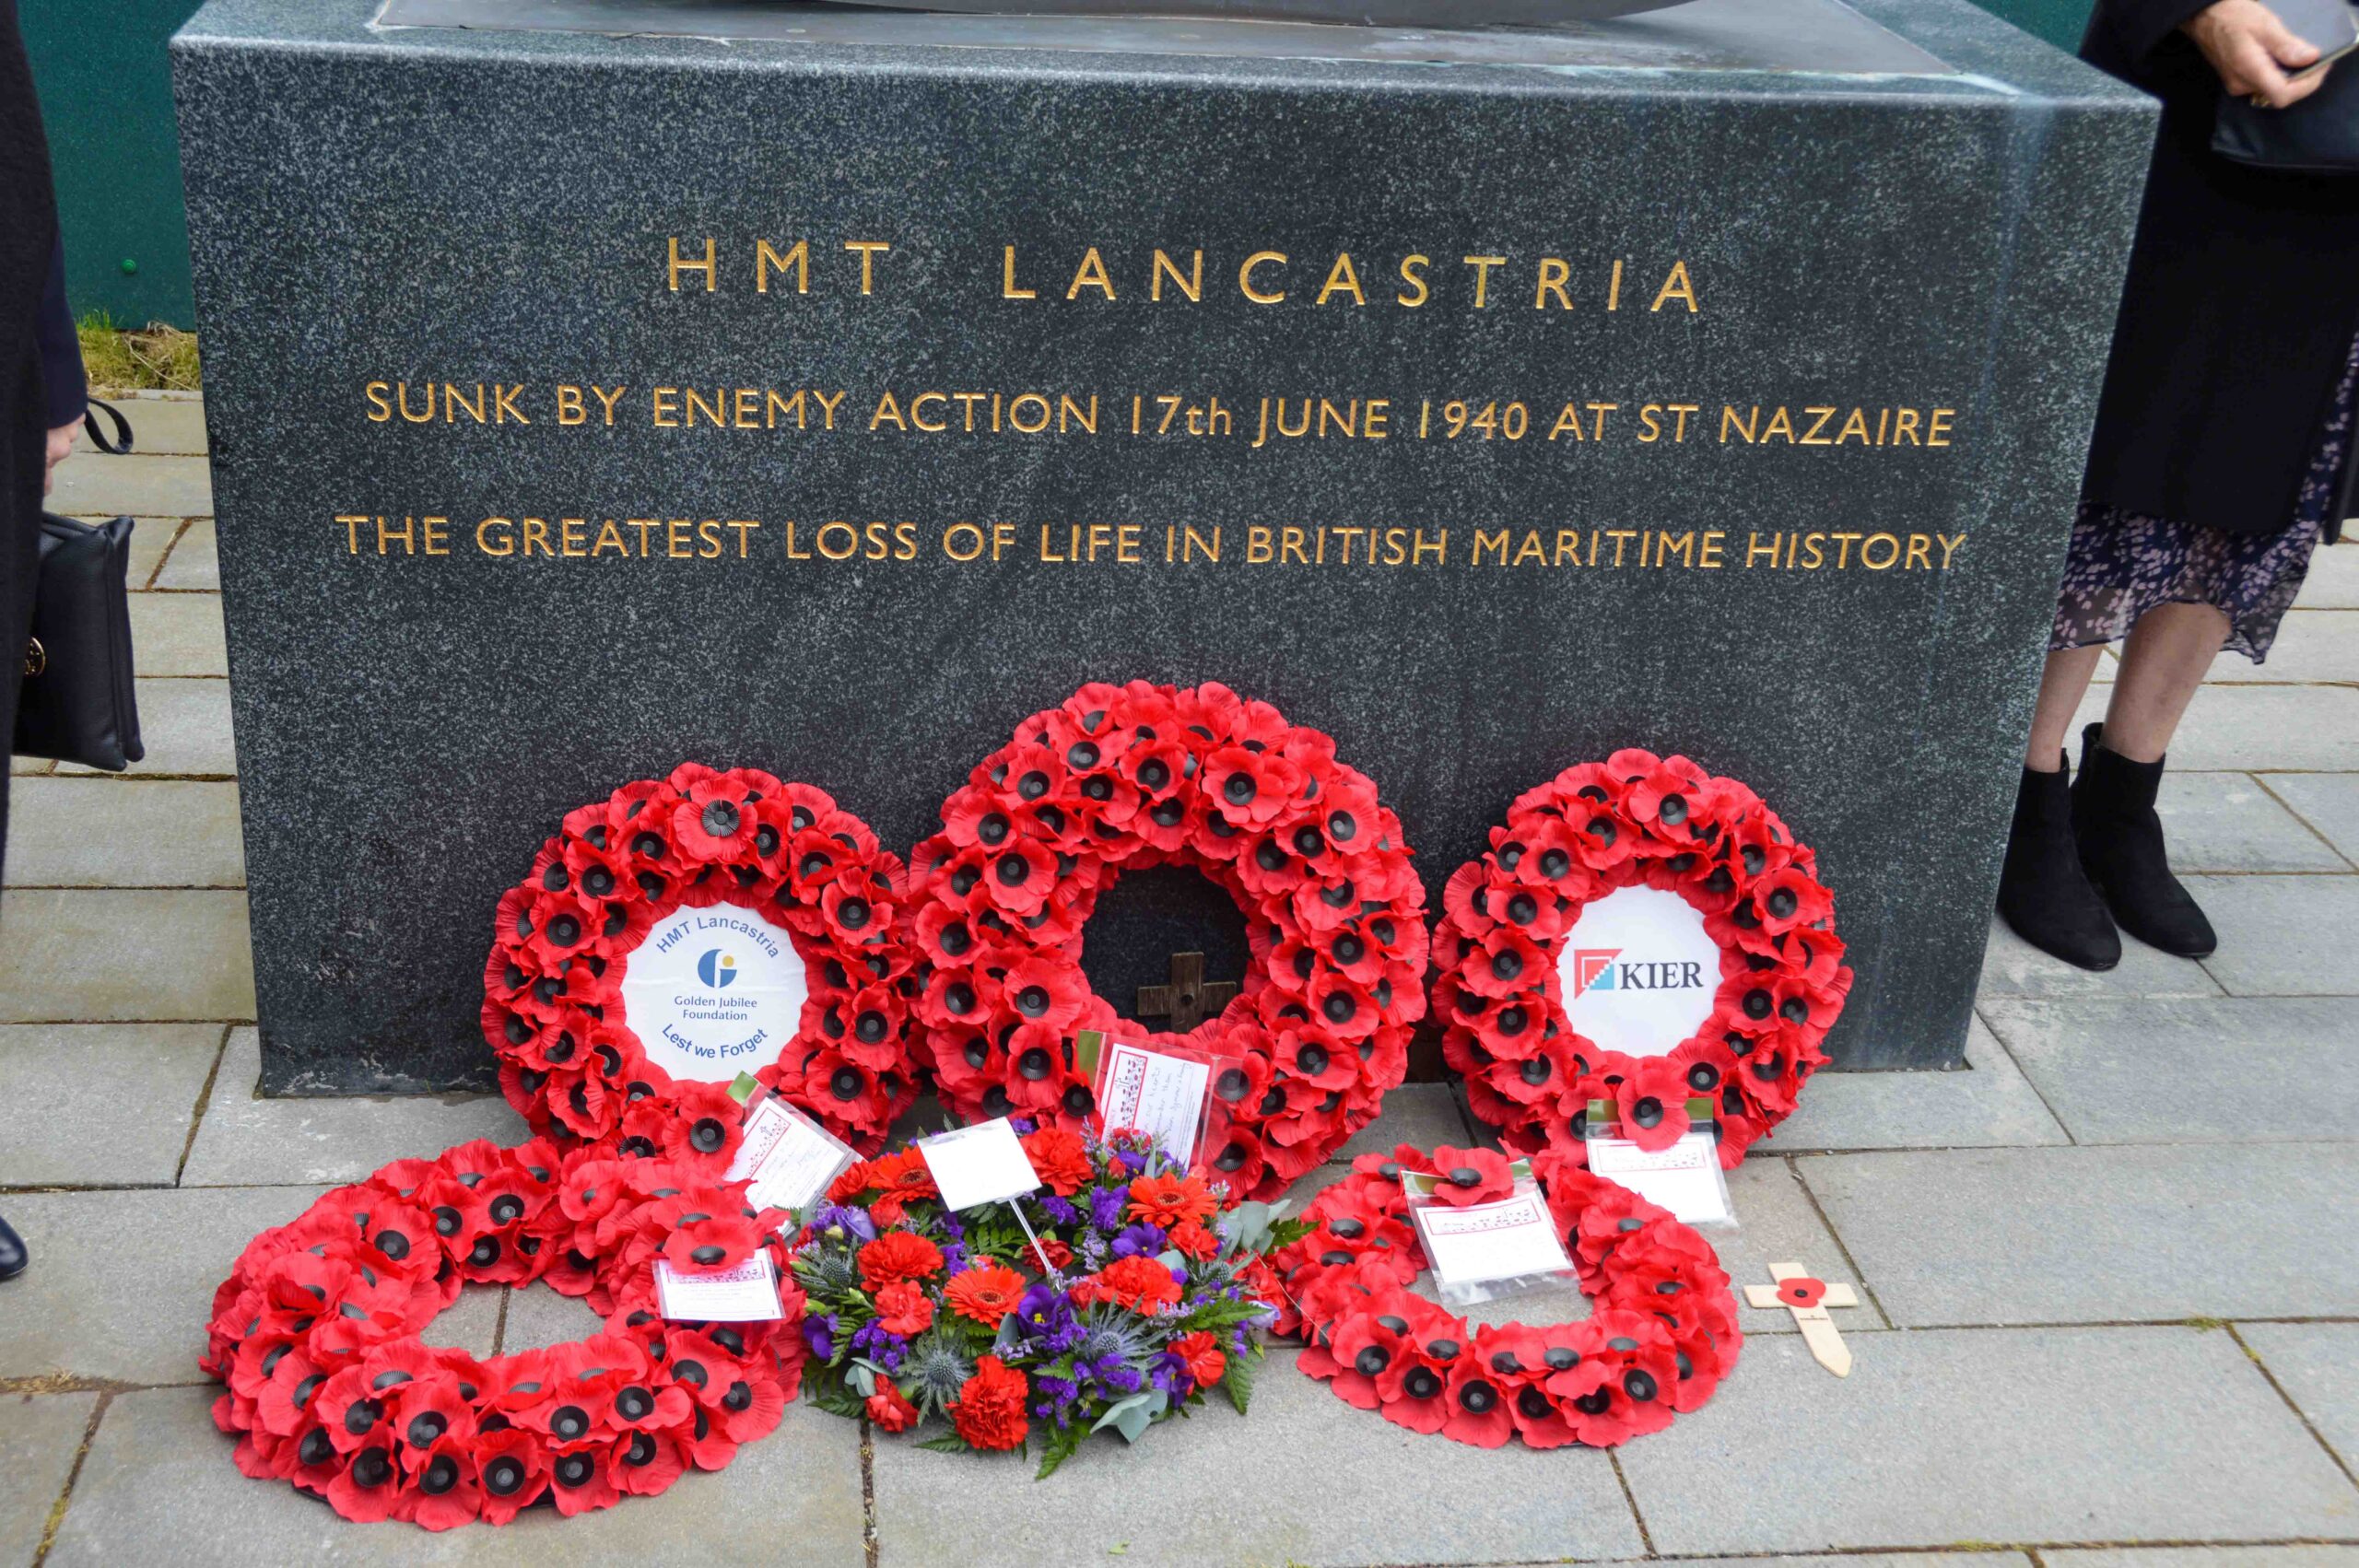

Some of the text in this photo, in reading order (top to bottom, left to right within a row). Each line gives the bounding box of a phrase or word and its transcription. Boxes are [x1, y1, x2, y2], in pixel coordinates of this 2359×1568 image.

[365, 380, 1956, 448] SUNK BY ENEMY ACTION 17th JUNE 1940 AT ST NAZAIRE
[334, 514, 1966, 570] THE GREATEST LOSS OF LIFE IN BRITISH MARITIME HISTORY
[656, 917, 780, 958] HMT Lancastria
[1619, 961, 1704, 990] KIER
[675, 995, 757, 1008] Golden Jubilee
[682, 1010, 748, 1021] Foundation
[662, 1024, 769, 1059] Lest we Forget
